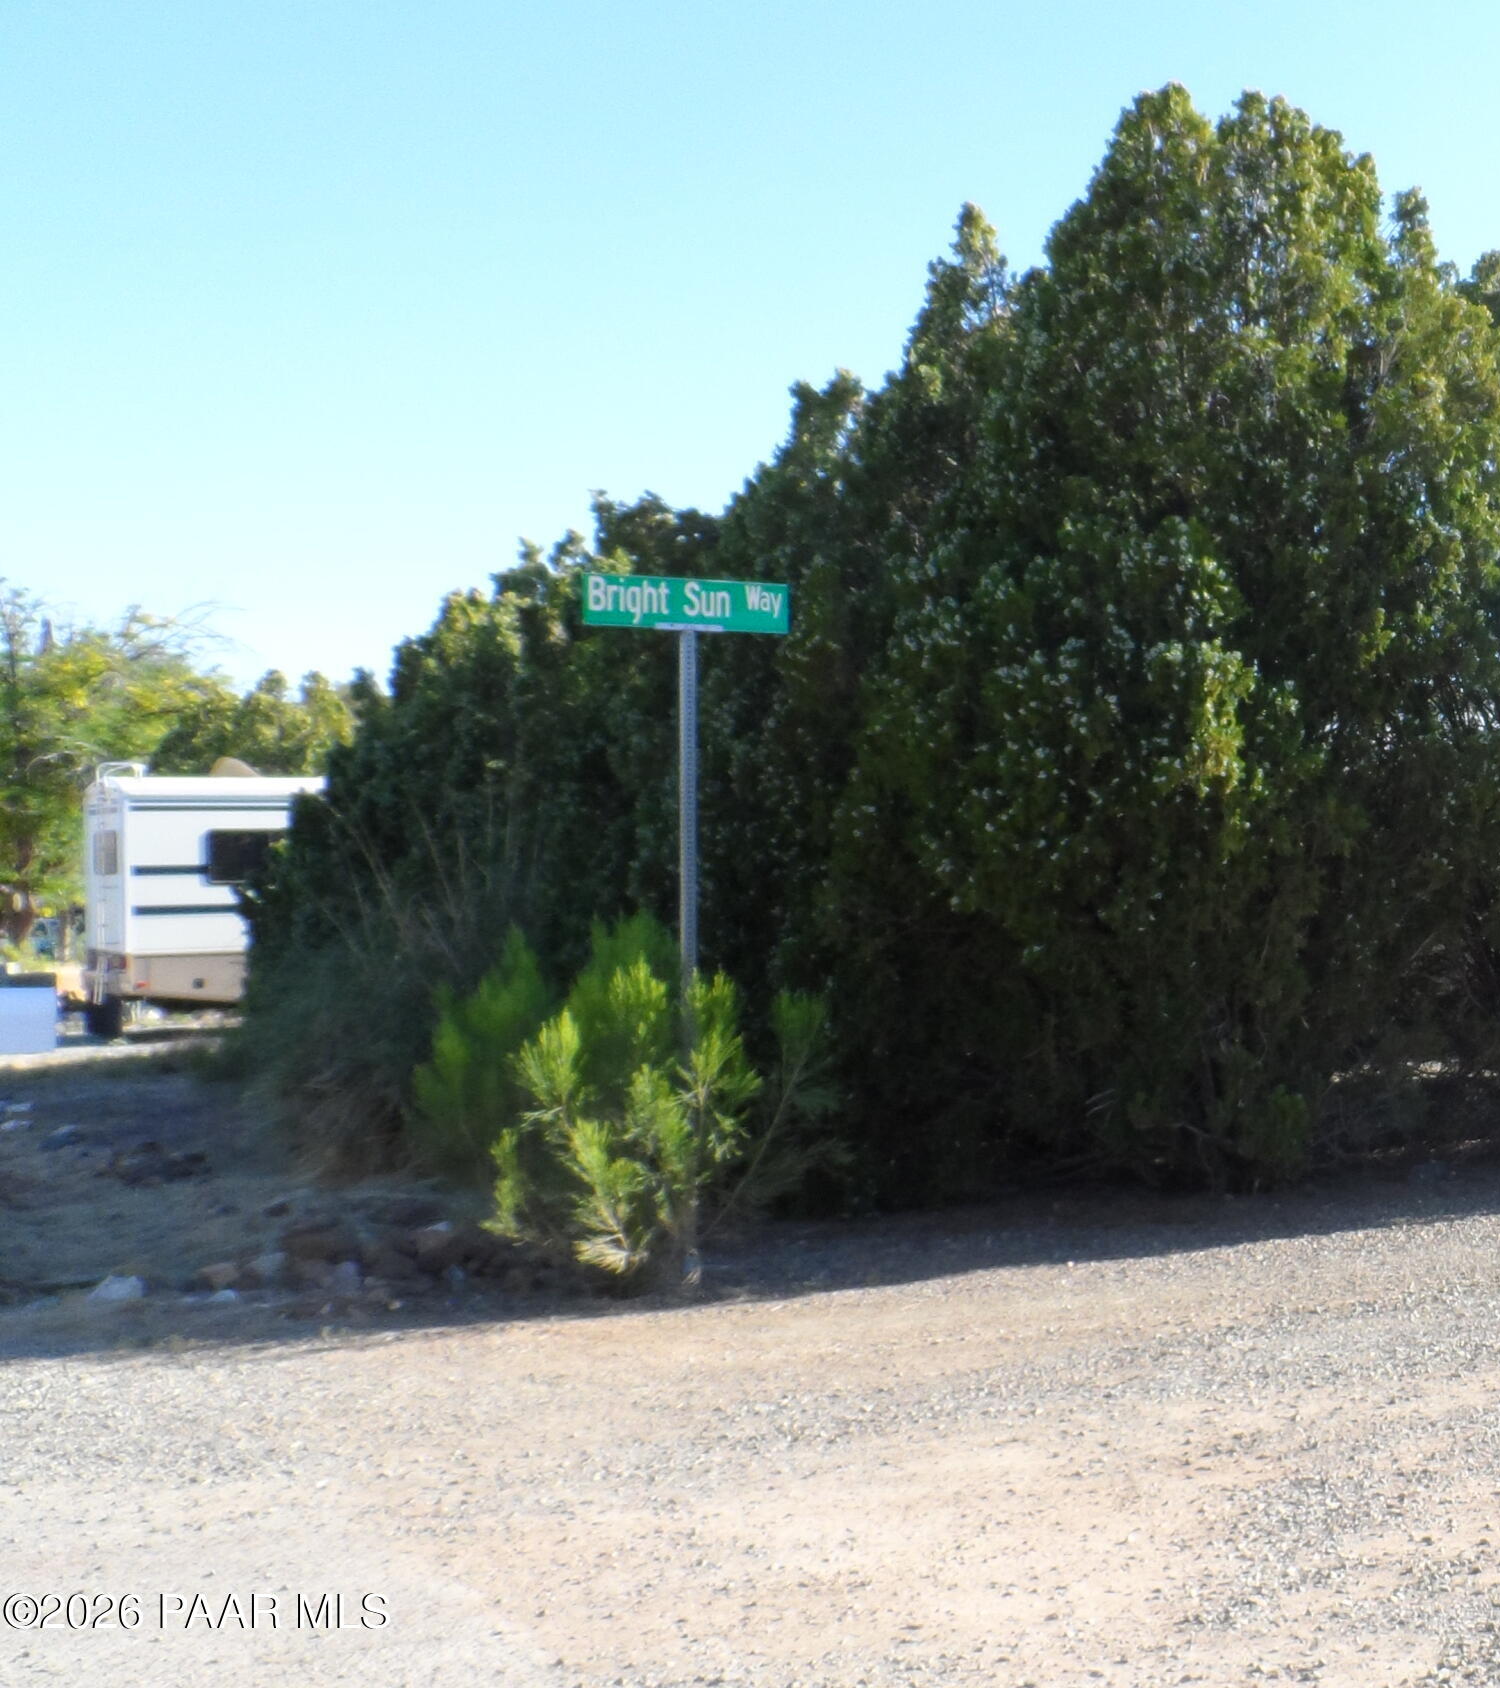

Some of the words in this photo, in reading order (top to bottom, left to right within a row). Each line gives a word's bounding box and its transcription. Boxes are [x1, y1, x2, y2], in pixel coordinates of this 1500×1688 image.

[588, 576, 669, 624] Bright
[683, 581, 730, 618] Sun
[744, 584, 782, 618] Way
